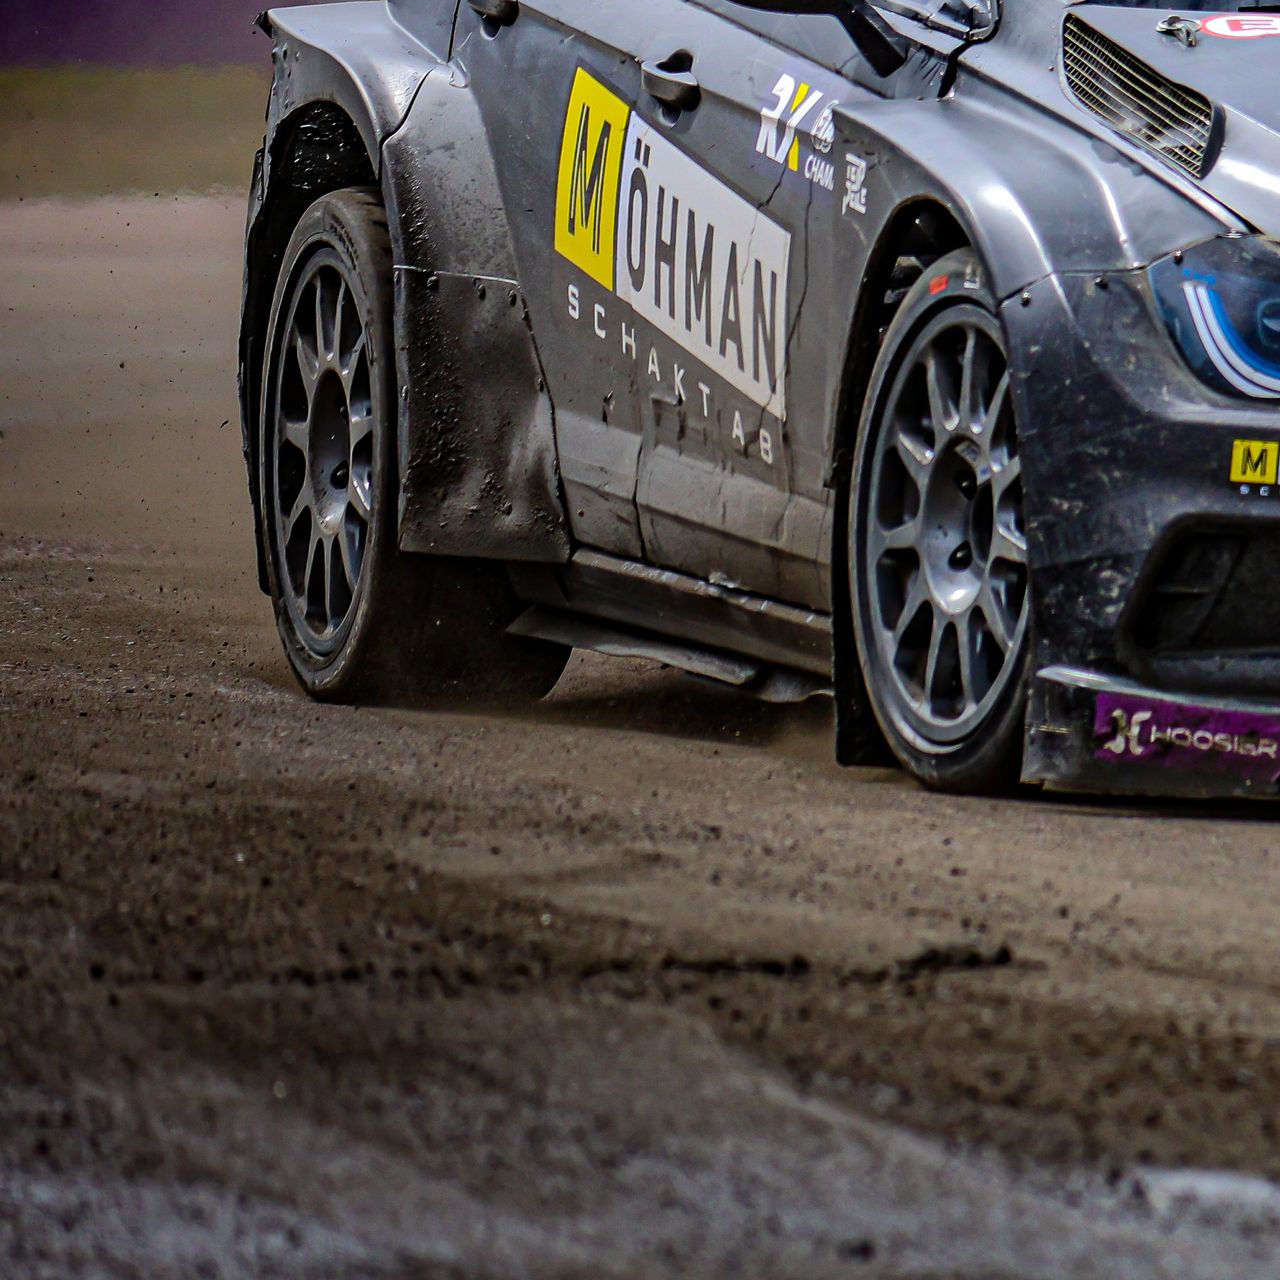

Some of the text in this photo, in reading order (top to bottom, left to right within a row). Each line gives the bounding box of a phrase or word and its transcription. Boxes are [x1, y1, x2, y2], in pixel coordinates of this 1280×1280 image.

[568, 102, 778, 395] M ÖHMAN
[567, 283, 774, 465] SCHAKT AB
[1241, 447, 1268, 477] M
